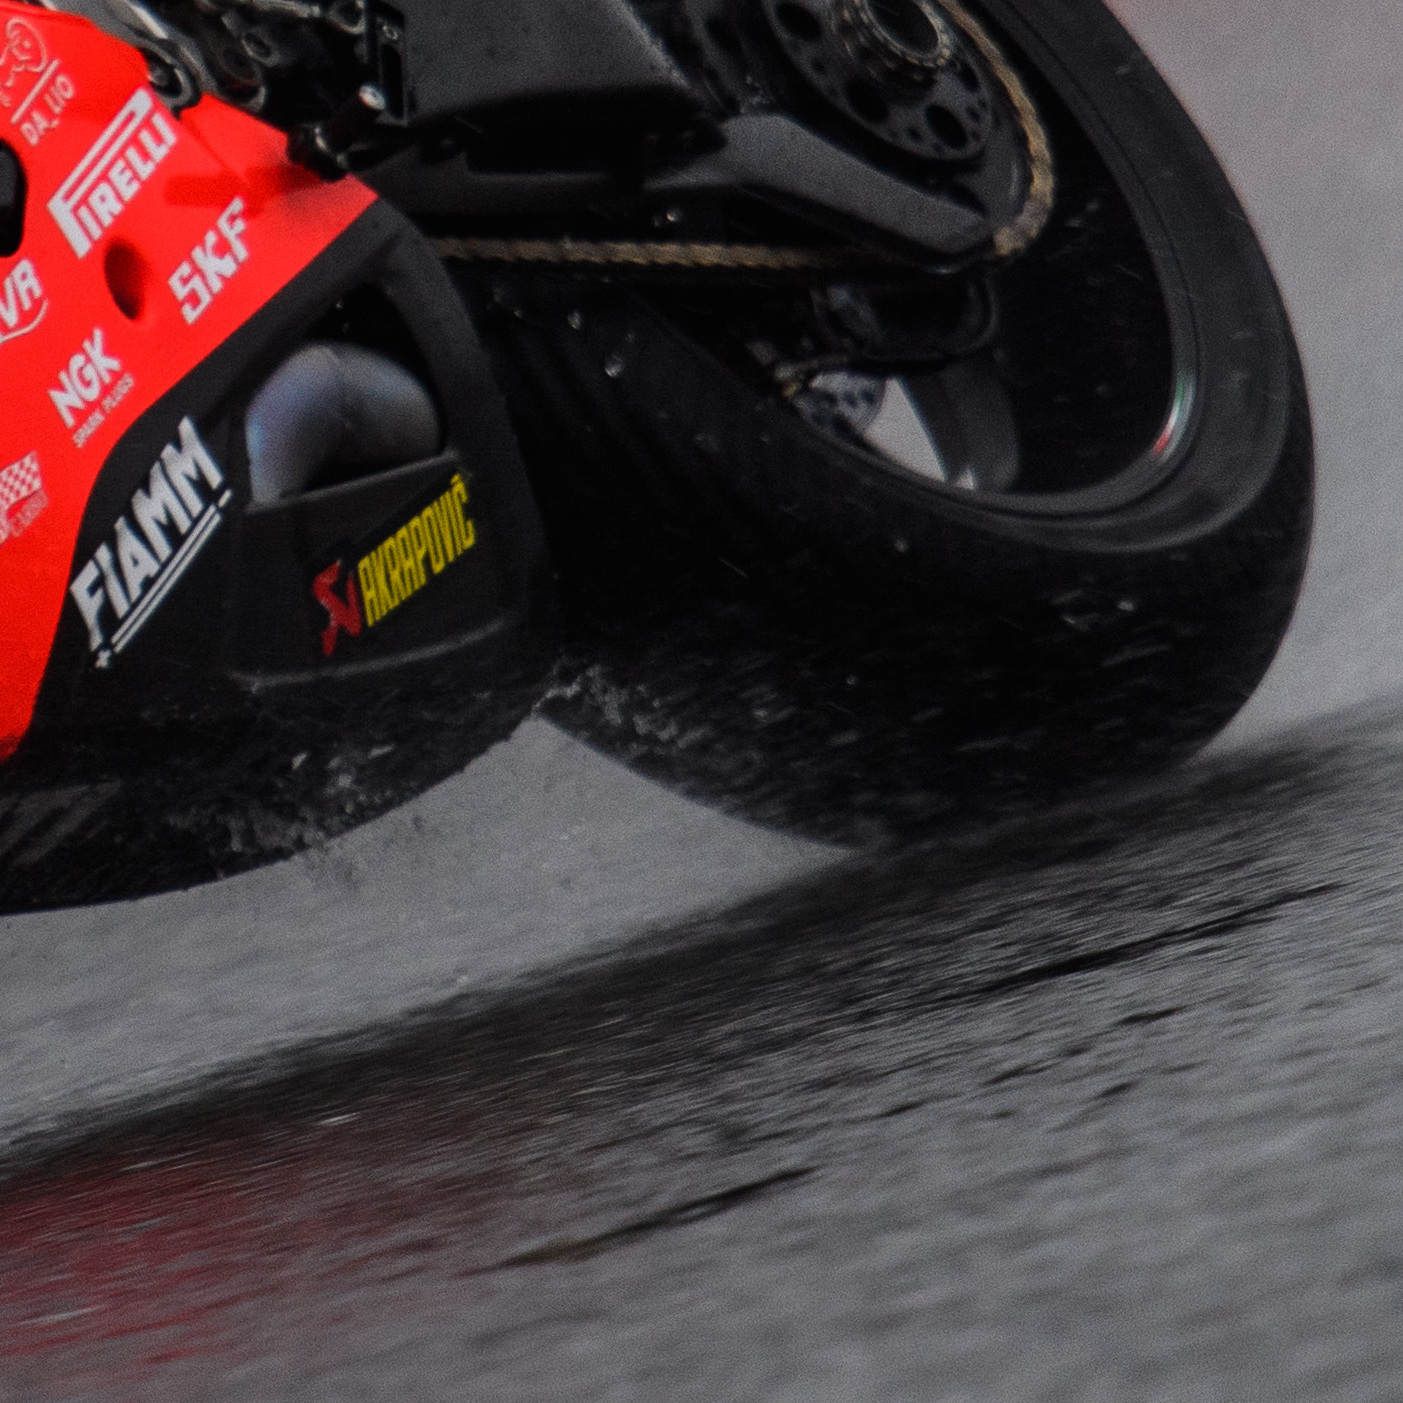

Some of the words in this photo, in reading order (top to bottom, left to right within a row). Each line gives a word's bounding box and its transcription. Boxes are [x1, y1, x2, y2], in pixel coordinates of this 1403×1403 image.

[46, 85, 177, 259] PIRELLI
[168, 196, 249, 325] SKF
[47, 327, 122, 430] NGK
[70, 415, 225, 653] FIAMM
